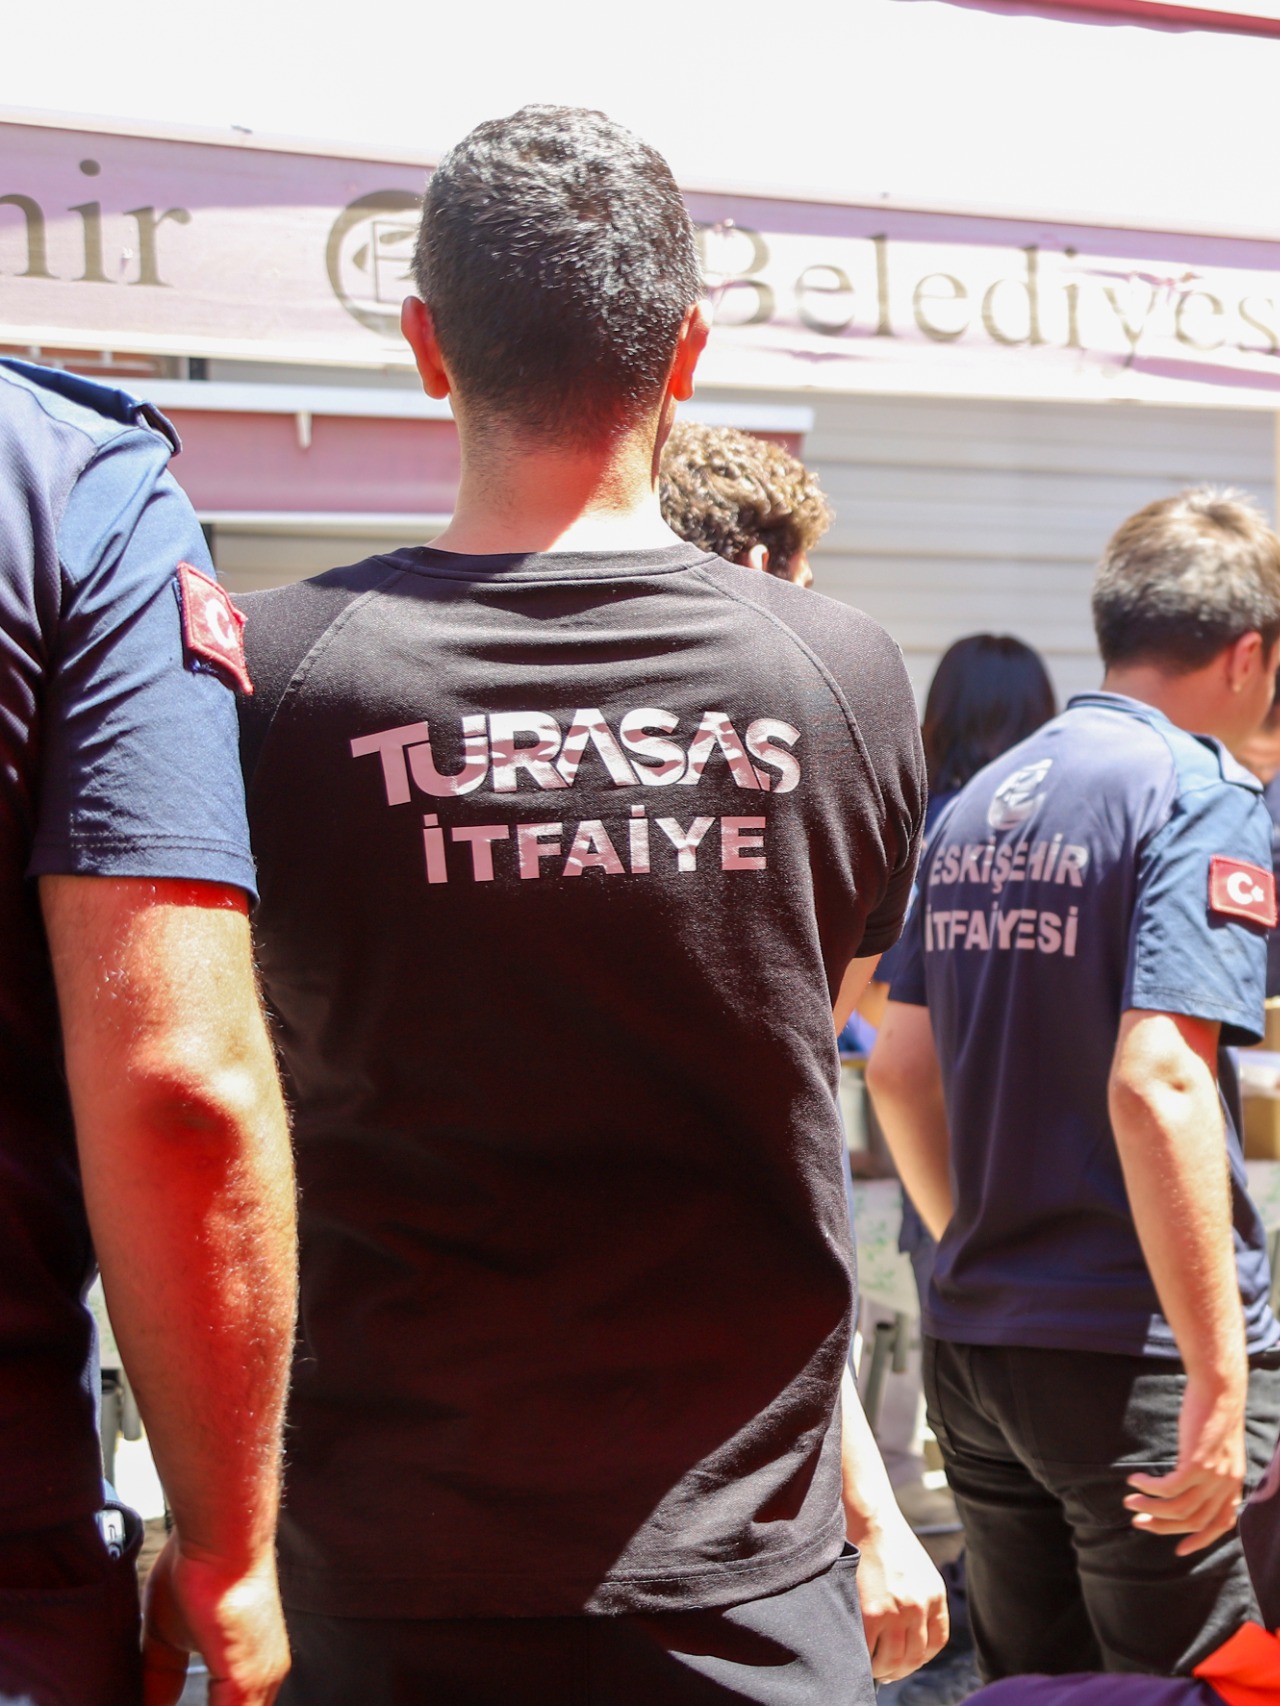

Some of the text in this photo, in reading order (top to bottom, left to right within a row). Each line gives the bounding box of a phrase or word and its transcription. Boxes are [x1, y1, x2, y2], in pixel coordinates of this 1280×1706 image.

[350, 707, 801, 807] TURASAS
[423, 804, 767, 884] İTFAİYE
[929, 832, 1089, 894] ESKİŞEHİR
[925, 901, 1079, 958] İTFAİYESİ
